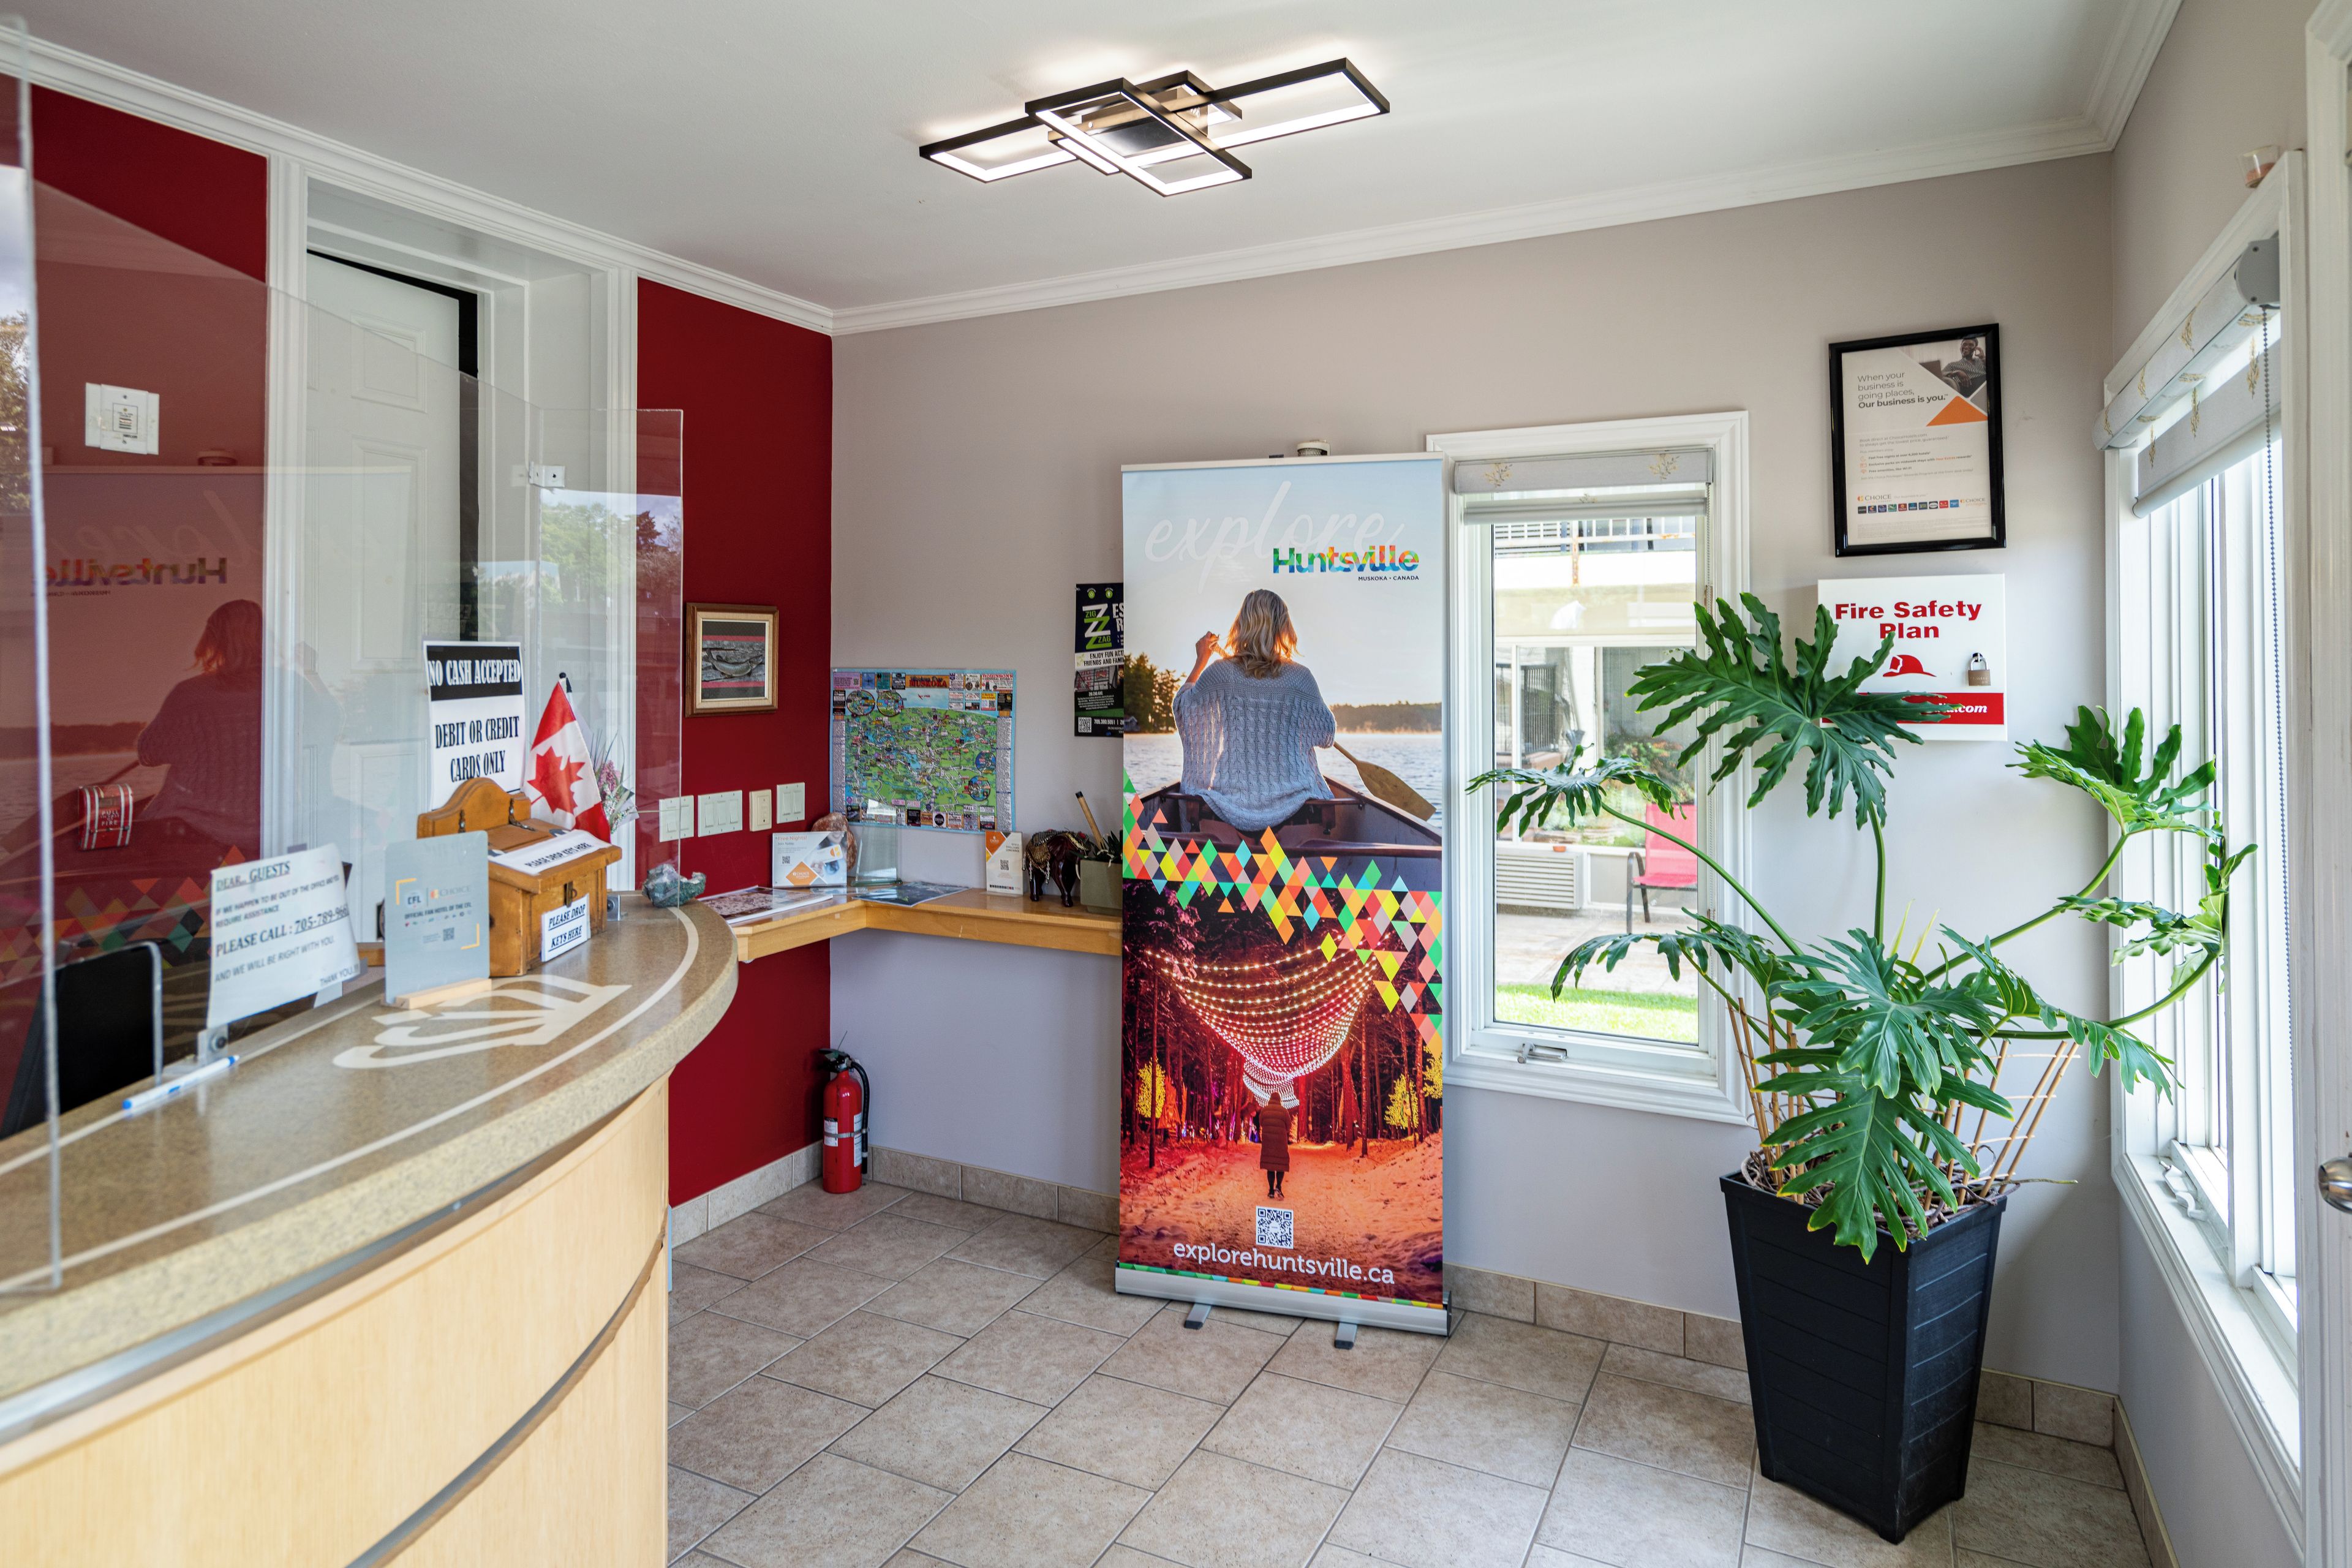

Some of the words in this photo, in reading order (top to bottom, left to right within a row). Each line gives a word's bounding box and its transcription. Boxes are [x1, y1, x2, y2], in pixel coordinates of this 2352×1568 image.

[1858, 381, 1895, 391] business
[1886, 372, 1905, 382] your
[1858, 391, 1883, 401] going
[1885, 388, 1915, 398] places,
[1877, 398, 1915, 407] business
[1144, 480, 1404, 594] explore
[1273, 545, 1419, 573] Huntsville
[1836, 603, 1884, 619] Fire
[1894, 600, 1982, 621] Safety
[1880, 623, 1939, 638] Plan
[428, 660, 443, 687] NO
[445, 660, 472, 685] CASH
[474, 659, 521, 684] ACCEPTED
[909, 679, 948, 688] MUSKOKA
[435, 722, 466, 748] DEBIT
[469, 720, 482, 744] OR
[485, 716, 519, 742] CREDIT
[450, 754, 481, 783] CARDS
[483, 750, 505, 776] ONLY
[524, 856, 550, 867] PLEASE
[549, 851, 564, 861] DROP
[562, 847, 576, 856] KEYS
[576, 842, 592, 851] HERE
[249, 861, 290, 882] GUESTS
[407, 895, 421, 905] CFL
[440, 885, 472, 897] CHOICE
[235, 898, 259, 909] HAPPEN
[261, 895, 270, 903] TO
[216, 914, 241, 928] REQUIRE
[244, 904, 279, 920] ASSISTANCE
[404, 910, 424, 920] OFFICIAL
[549, 910, 570, 929] PLEASE
[571, 903, 586, 917] DROP
[216, 933, 257, 957] PLEASE
[260, 924, 287, 943] CALL
[551, 933, 567, 948] KEYS
[567, 925, 582, 940] HERE
[215, 970, 231, 983] AND
[233, 964, 246, 976] WE
[247, 958, 265, 971] WILL
[267, 955, 276, 966] BE
[278, 948, 300, 962] RIGHT
[301, 940, 320, 952] WITH
[320, 973, 338, 986] THANK
[1172, 1242, 1395, 1284] explorehuntsville.ca
